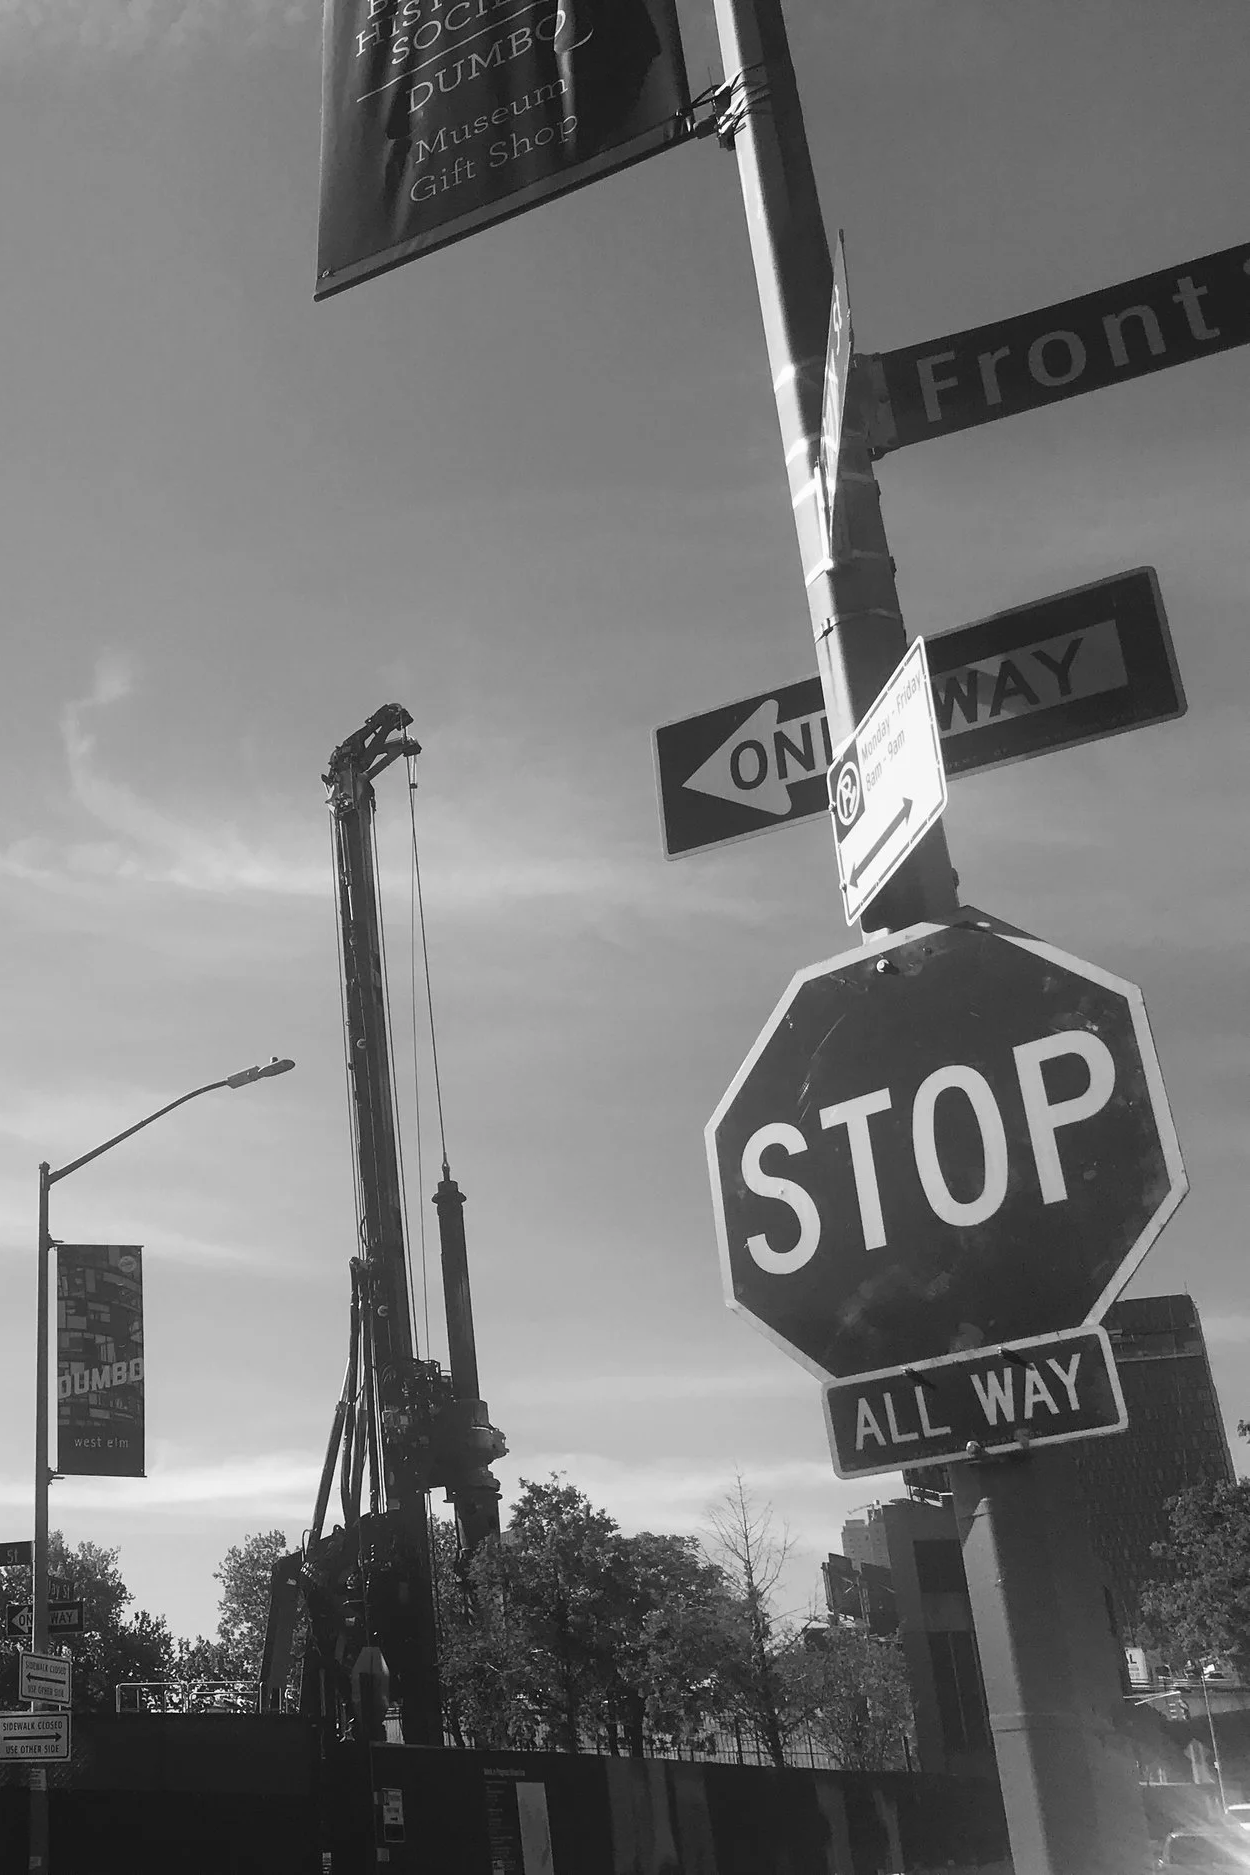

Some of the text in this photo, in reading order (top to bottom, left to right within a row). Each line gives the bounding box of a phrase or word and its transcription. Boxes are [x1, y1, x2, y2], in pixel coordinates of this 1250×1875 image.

[406, 9, 566, 114] DUMBO
[410, 114, 579, 202] Gift Shop
[413, 78, 570, 164] Museum
[916, 276, 1221, 423] Front
[861, 714, 891, 764] Monday
[896, 669, 922, 714] Friday
[932, 637, 1084, 732] WAY
[865, 763, 883, 793] 8am
[888, 728, 906, 763] 9am
[740, 1030, 1116, 1275] STOP
[57, 1357, 144, 1399] DUMBO
[855, 1353, 1081, 1450] ALL WAY
[74, 1436, 130, 1449] west elm
[7, 1548, 18, 1563] St
[19, 1611, 73, 1627] ON WAY
[3, 1720, 63, 1731] SIDEWALK CLOSED
[5, 1744, 60, 1754] USE OTHER SIDE
